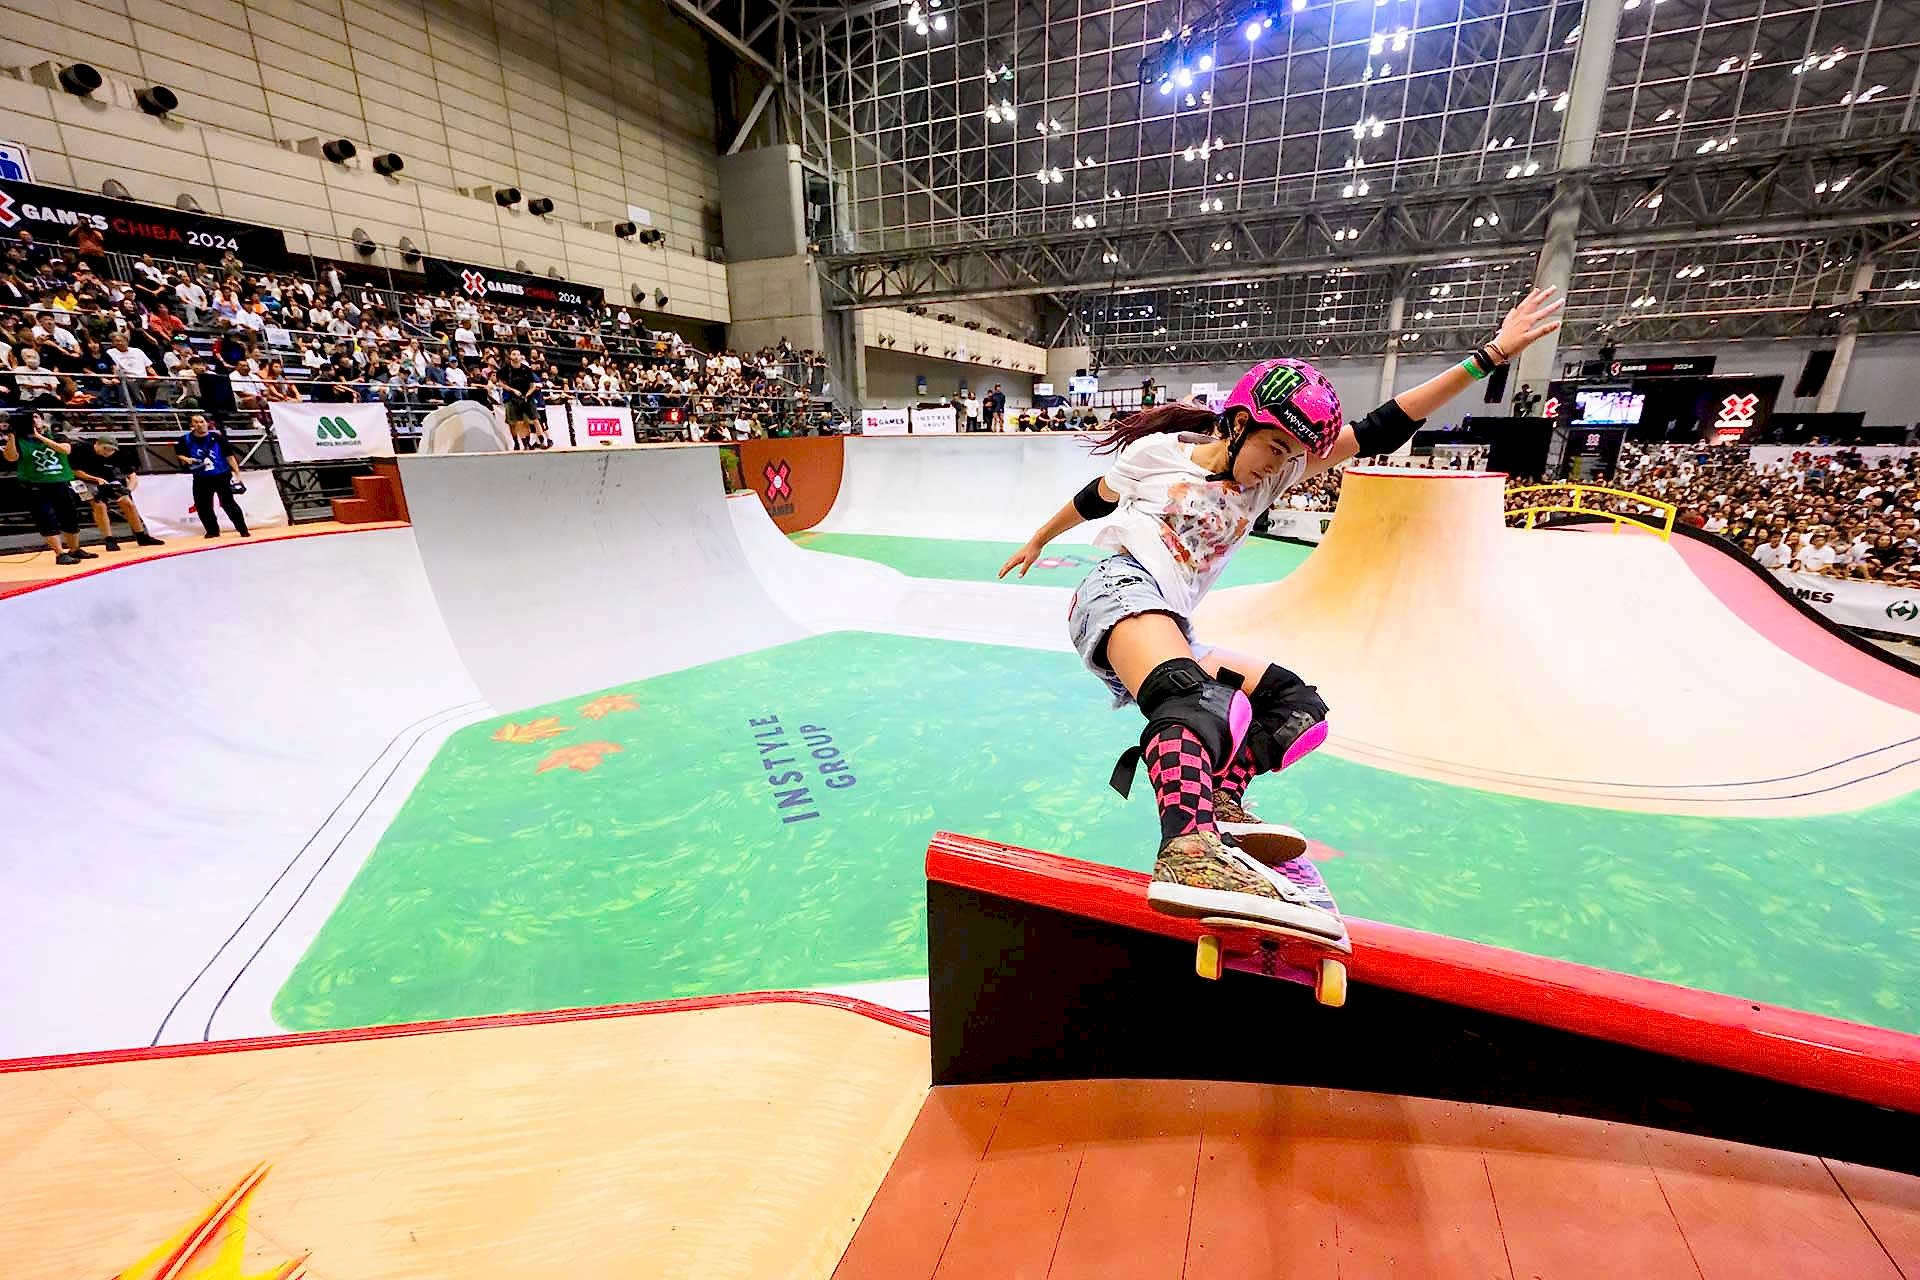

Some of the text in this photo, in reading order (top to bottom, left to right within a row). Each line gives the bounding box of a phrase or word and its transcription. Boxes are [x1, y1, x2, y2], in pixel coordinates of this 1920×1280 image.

[111, 218, 182, 242] CHIBA
[186, 231, 239, 252] 2024
[487, 281, 524, 296] GAMES
[558, 292, 582, 304] 2024
[1783, 587, 1835, 604] AMES
[748, 714, 820, 824] INSTYLE
[799, 724, 857, 789] GROUP
